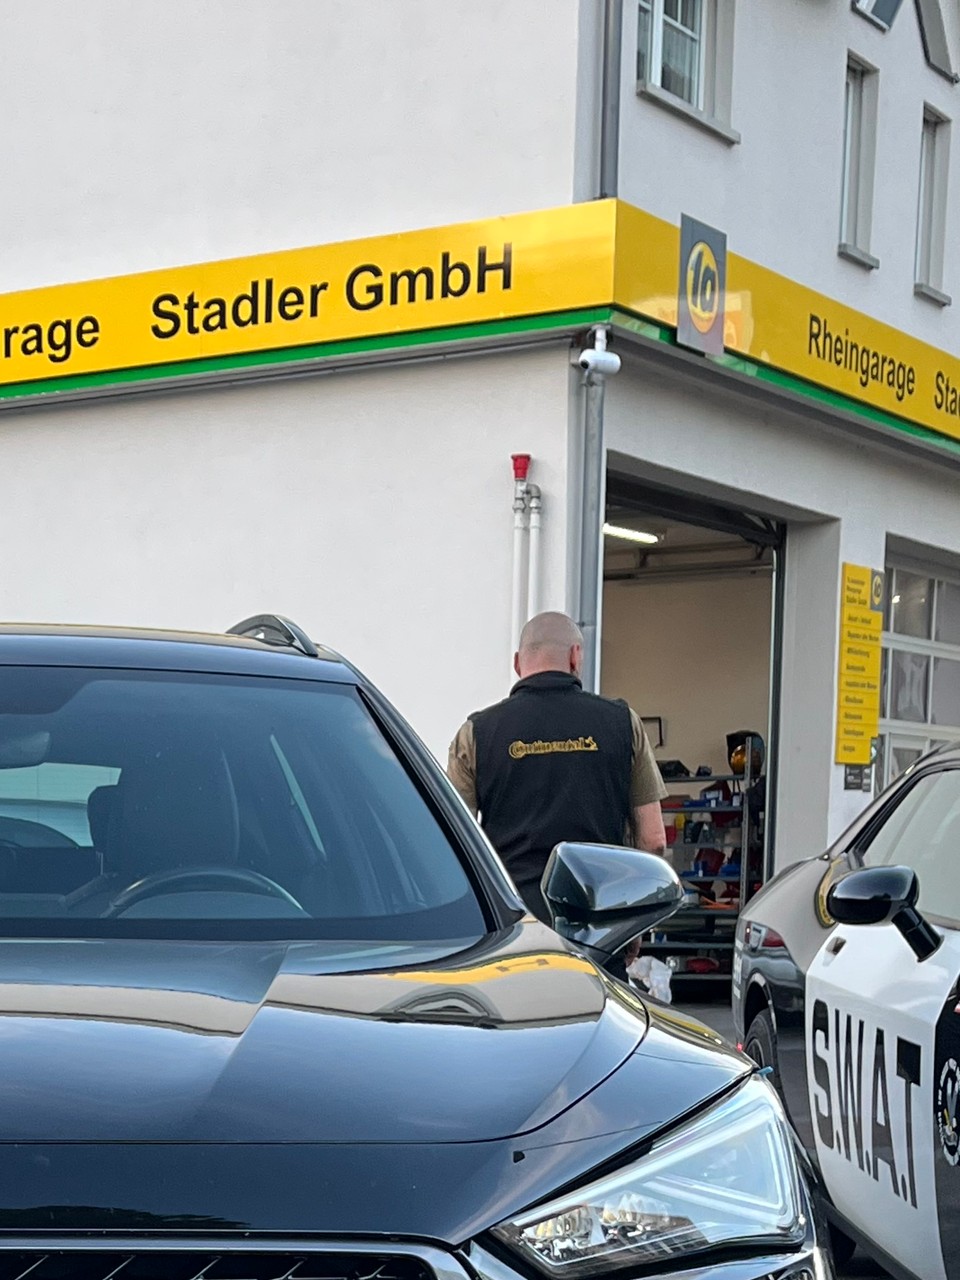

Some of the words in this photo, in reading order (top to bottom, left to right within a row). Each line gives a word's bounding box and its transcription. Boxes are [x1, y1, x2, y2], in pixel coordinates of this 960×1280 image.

[150, 277, 329, 340] Stadler
[344, 242, 513, 312] GmbH
[808, 313, 916, 402] Rheingarage
[934, 370, 960, 418] Sta
